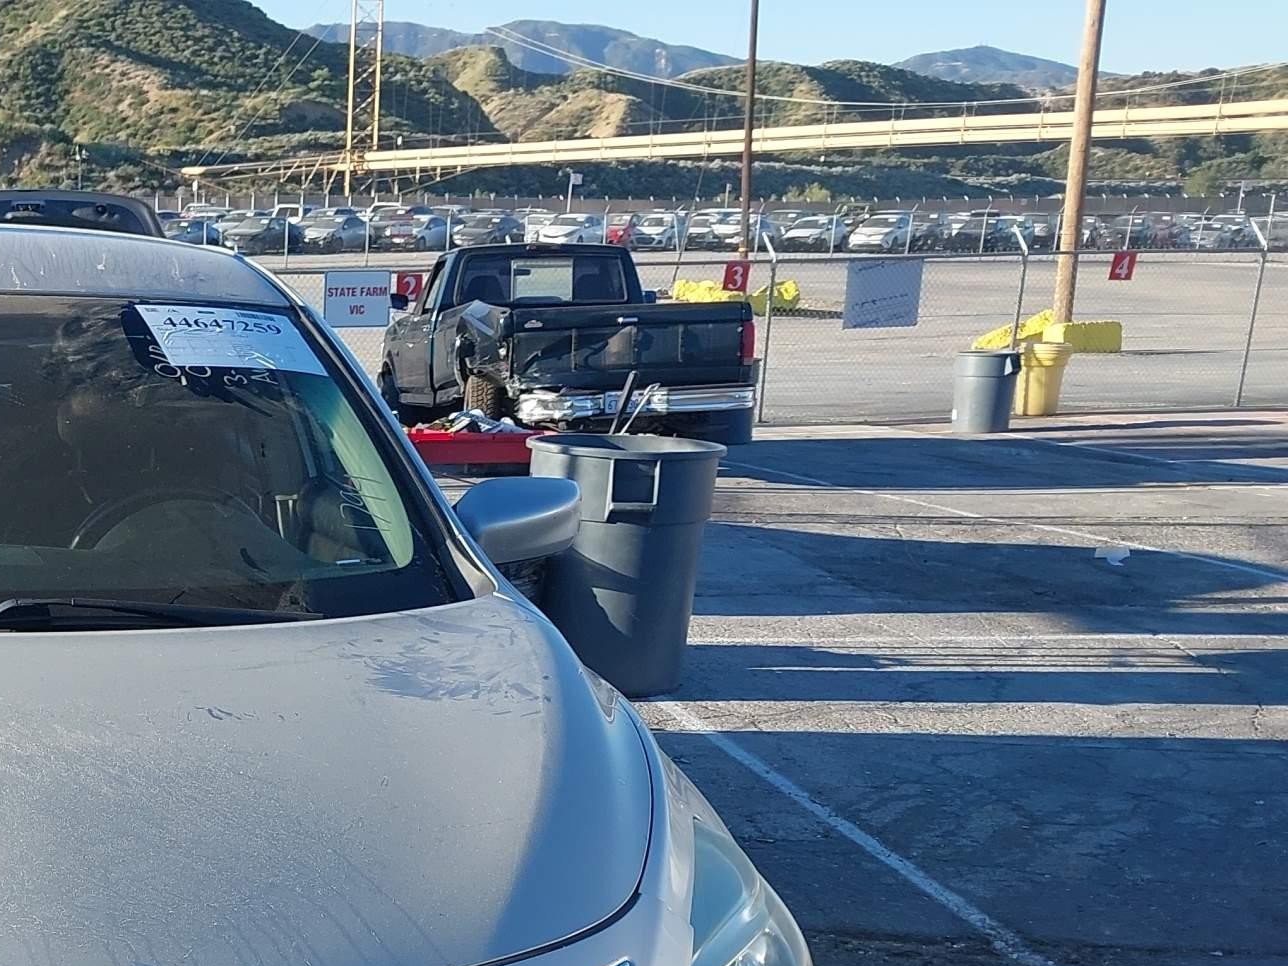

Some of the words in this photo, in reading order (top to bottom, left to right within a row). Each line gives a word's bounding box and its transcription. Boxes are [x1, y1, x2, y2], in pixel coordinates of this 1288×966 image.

[727, 265, 744, 290] 3
[1114, 255, 1130, 279] 4
[327, 287, 357, 297] STATE
[359, 286, 388, 297] FARM
[402, 276, 417, 301] 2
[349, 304, 365, 315] VIC
[162, 316, 283, 335] 44647259
